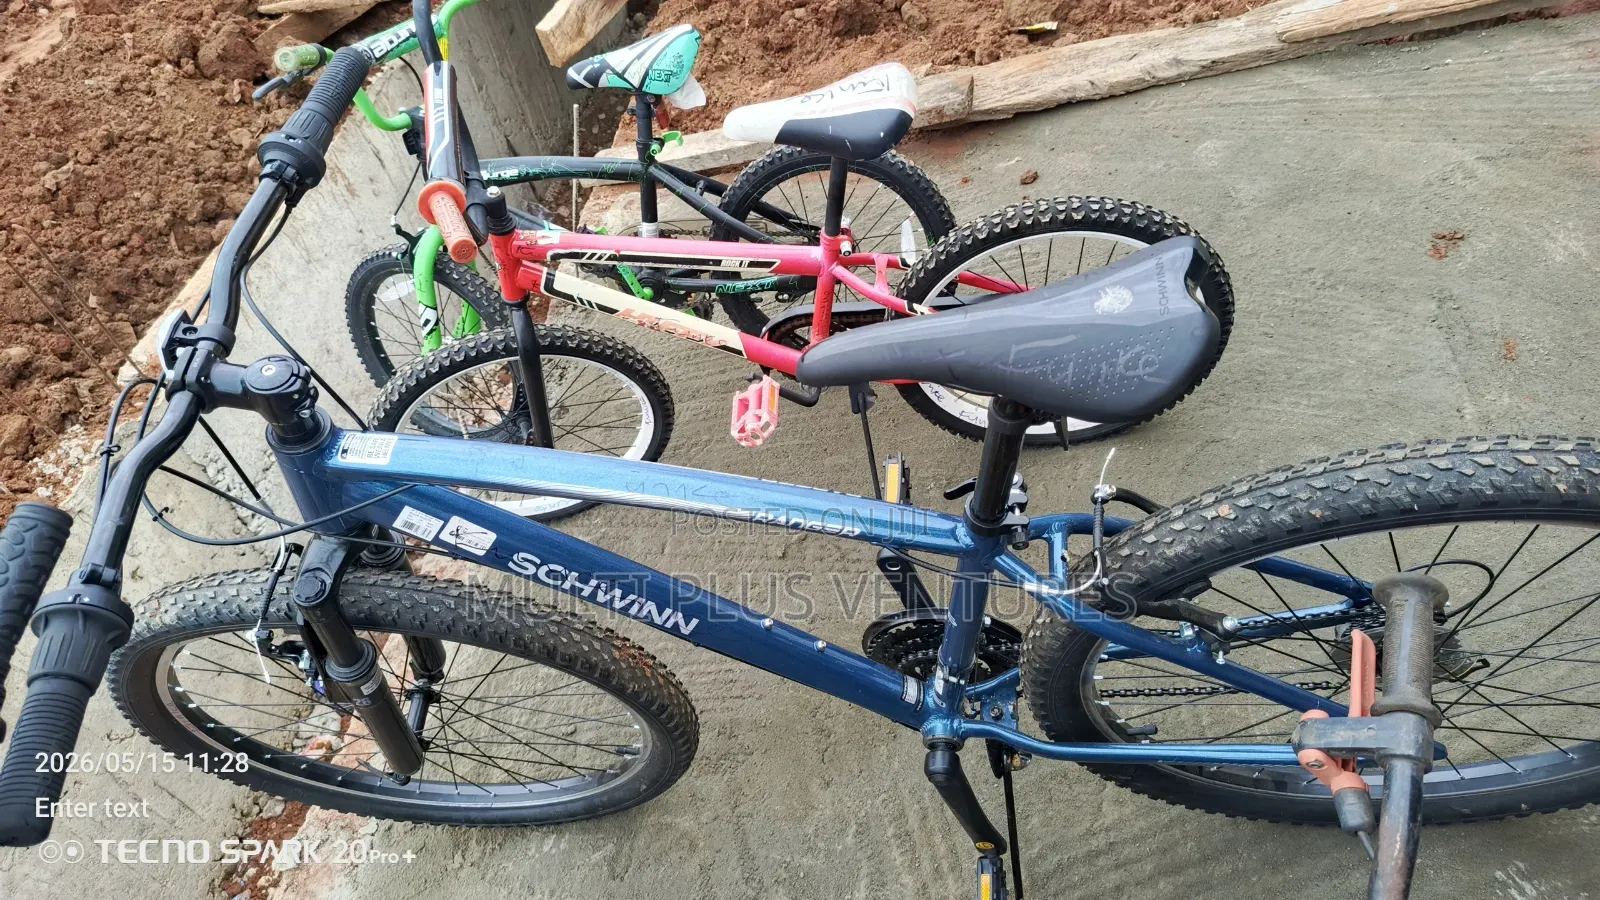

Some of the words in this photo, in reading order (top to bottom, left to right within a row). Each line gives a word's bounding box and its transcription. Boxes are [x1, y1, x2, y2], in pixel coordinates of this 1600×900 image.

[647, 68, 673, 83] NEXT
[720, 259, 740, 268] ROCK
[740, 260, 750, 268] IT
[715, 276, 779, 294] NEXT
[1154, 255, 1171, 317] SCHWINN
[508, 551, 700, 636] SCHWINN
[352, 696, 372, 707] 26
